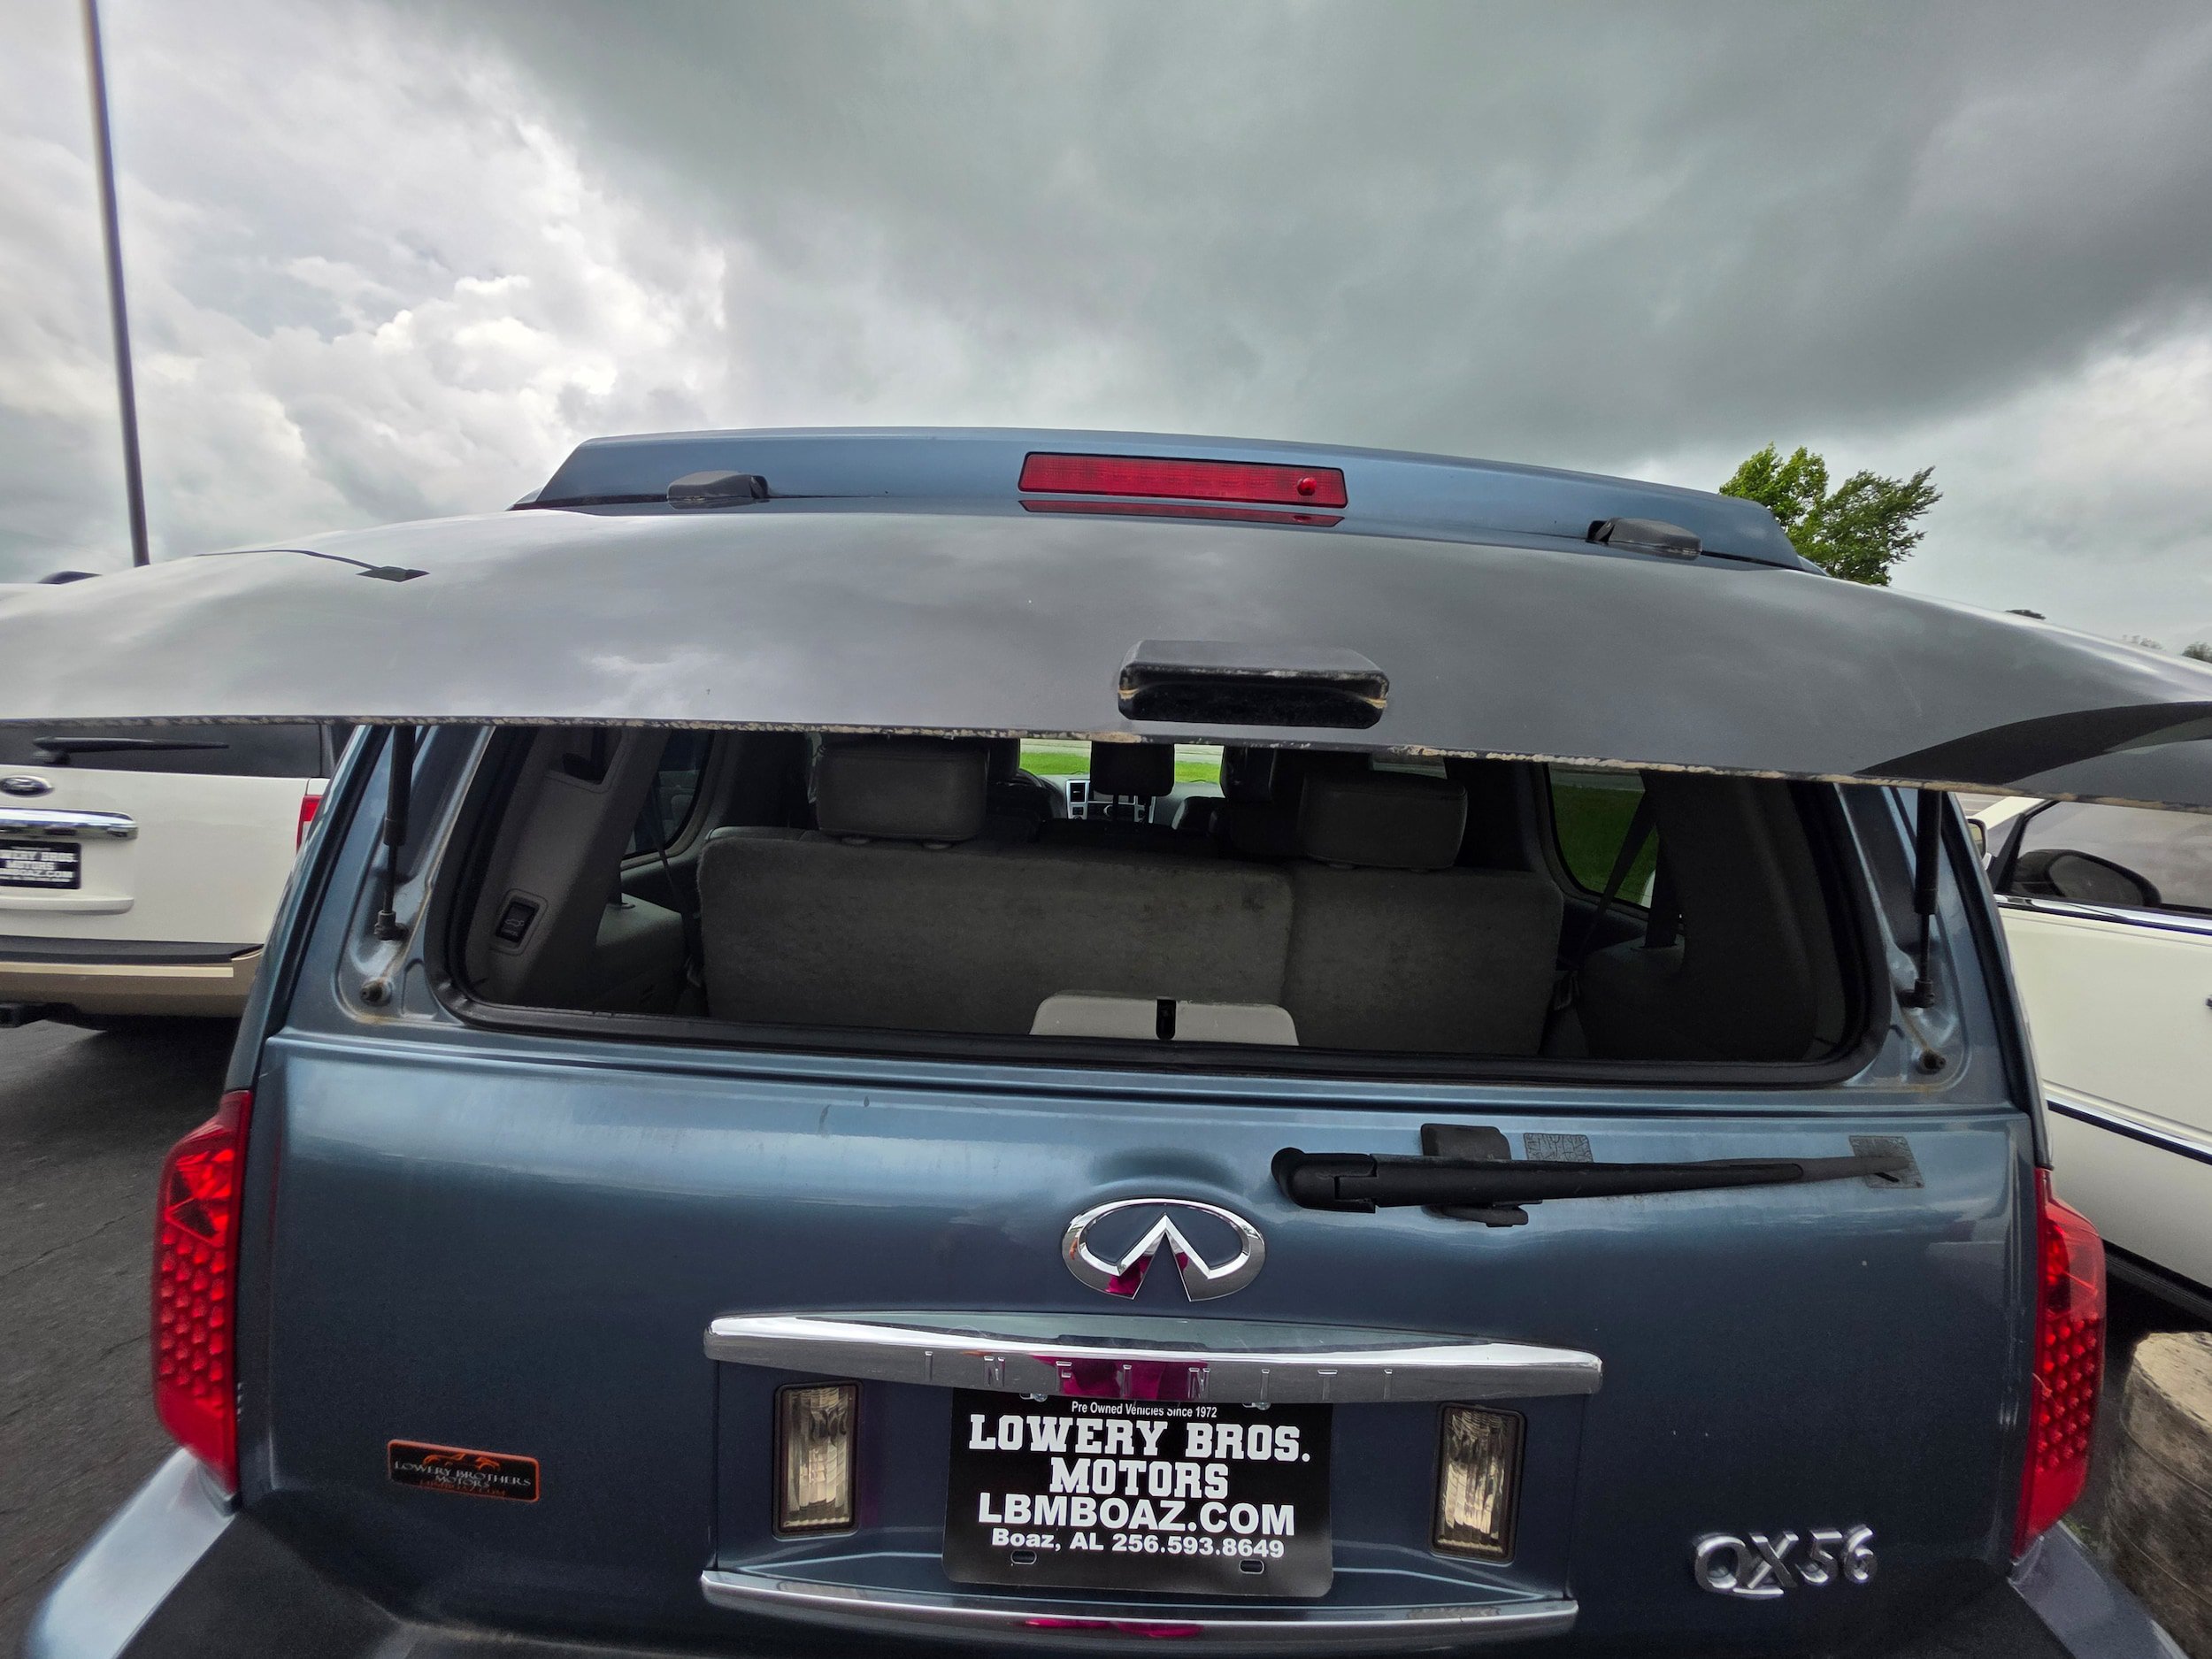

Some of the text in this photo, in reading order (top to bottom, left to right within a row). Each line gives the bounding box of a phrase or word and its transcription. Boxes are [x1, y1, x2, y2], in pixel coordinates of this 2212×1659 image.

[925, 1351, 1393, 1400] INFINITI
[1071, 1401, 1087, 1413] Pre
[1090, 1402, 1123, 1415] Owned
[1195, 1406, 1217, 1418] 1972
[969, 1414, 1310, 1462] LOWERY BROS.
[456, 1470, 532, 1486] BROTHERS
[1049, 1457, 1229, 1499] MOTORS
[979, 1492, 1294, 1536] LBMBOAZ.COM
[992, 1528, 1285, 1558] Boaz, AL 256.593.8649
[1693, 1524, 1878, 1600] QX56
